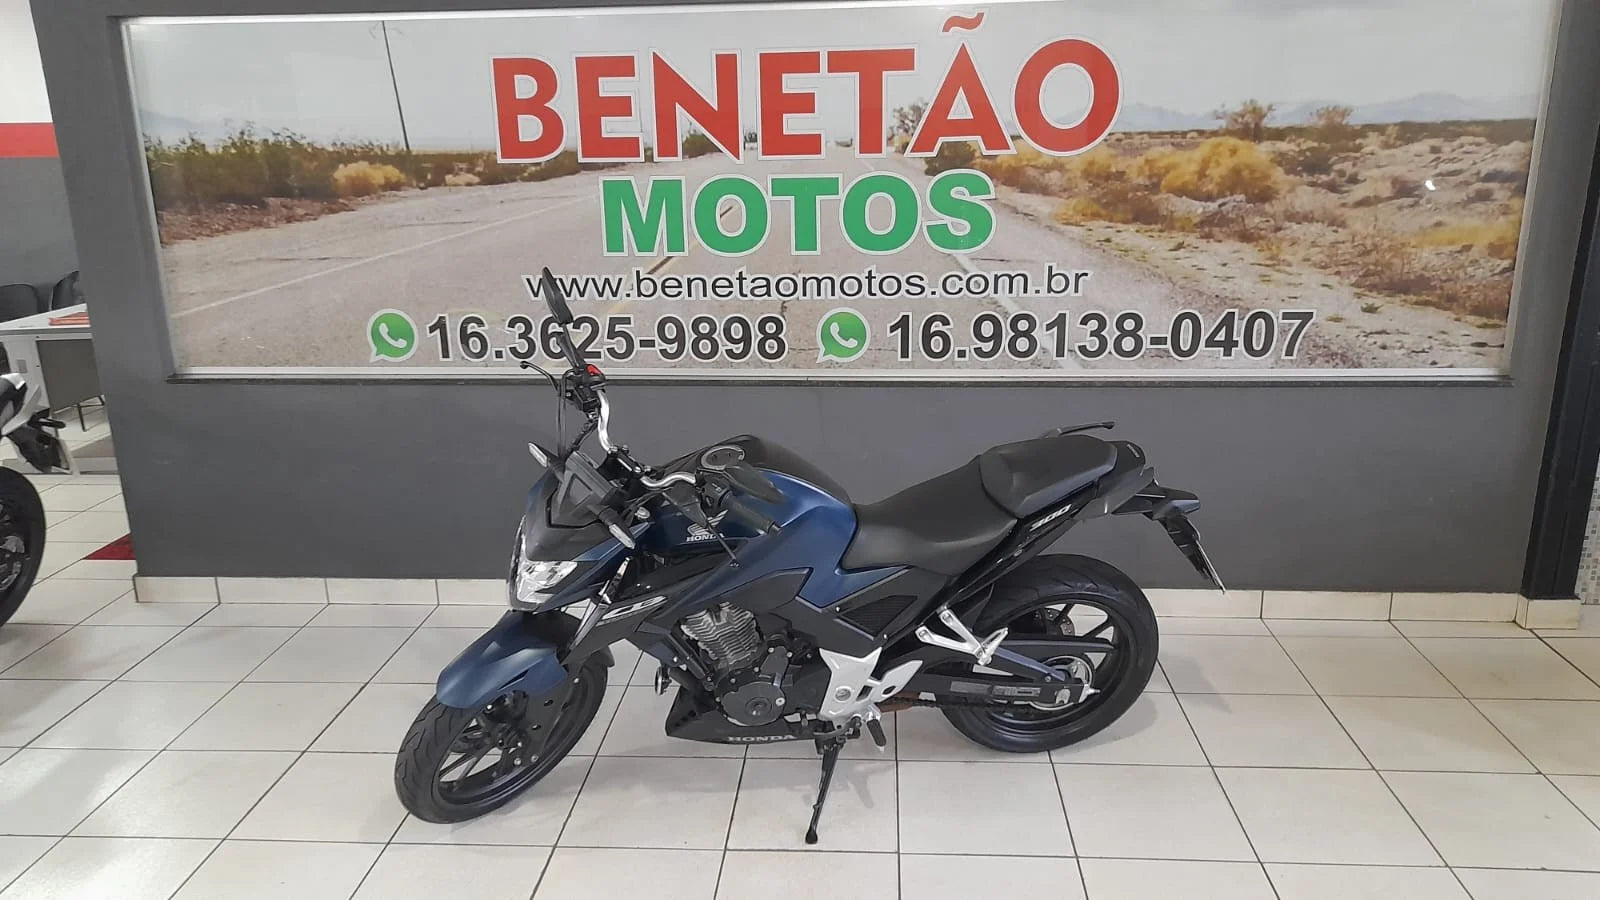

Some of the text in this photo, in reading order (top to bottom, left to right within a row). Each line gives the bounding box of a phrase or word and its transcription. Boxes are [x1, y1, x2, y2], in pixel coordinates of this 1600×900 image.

[492, 11, 1120, 162] BENETÃO
[602, 171, 995, 256] MOTOS
[524, 266, 1091, 300] www.benetaomotos.com.br
[427, 312, 787, 363] 16.3625-9898
[888, 311, 1315, 362] 16.98138-0407
[727, 733, 798, 743] HONDA
